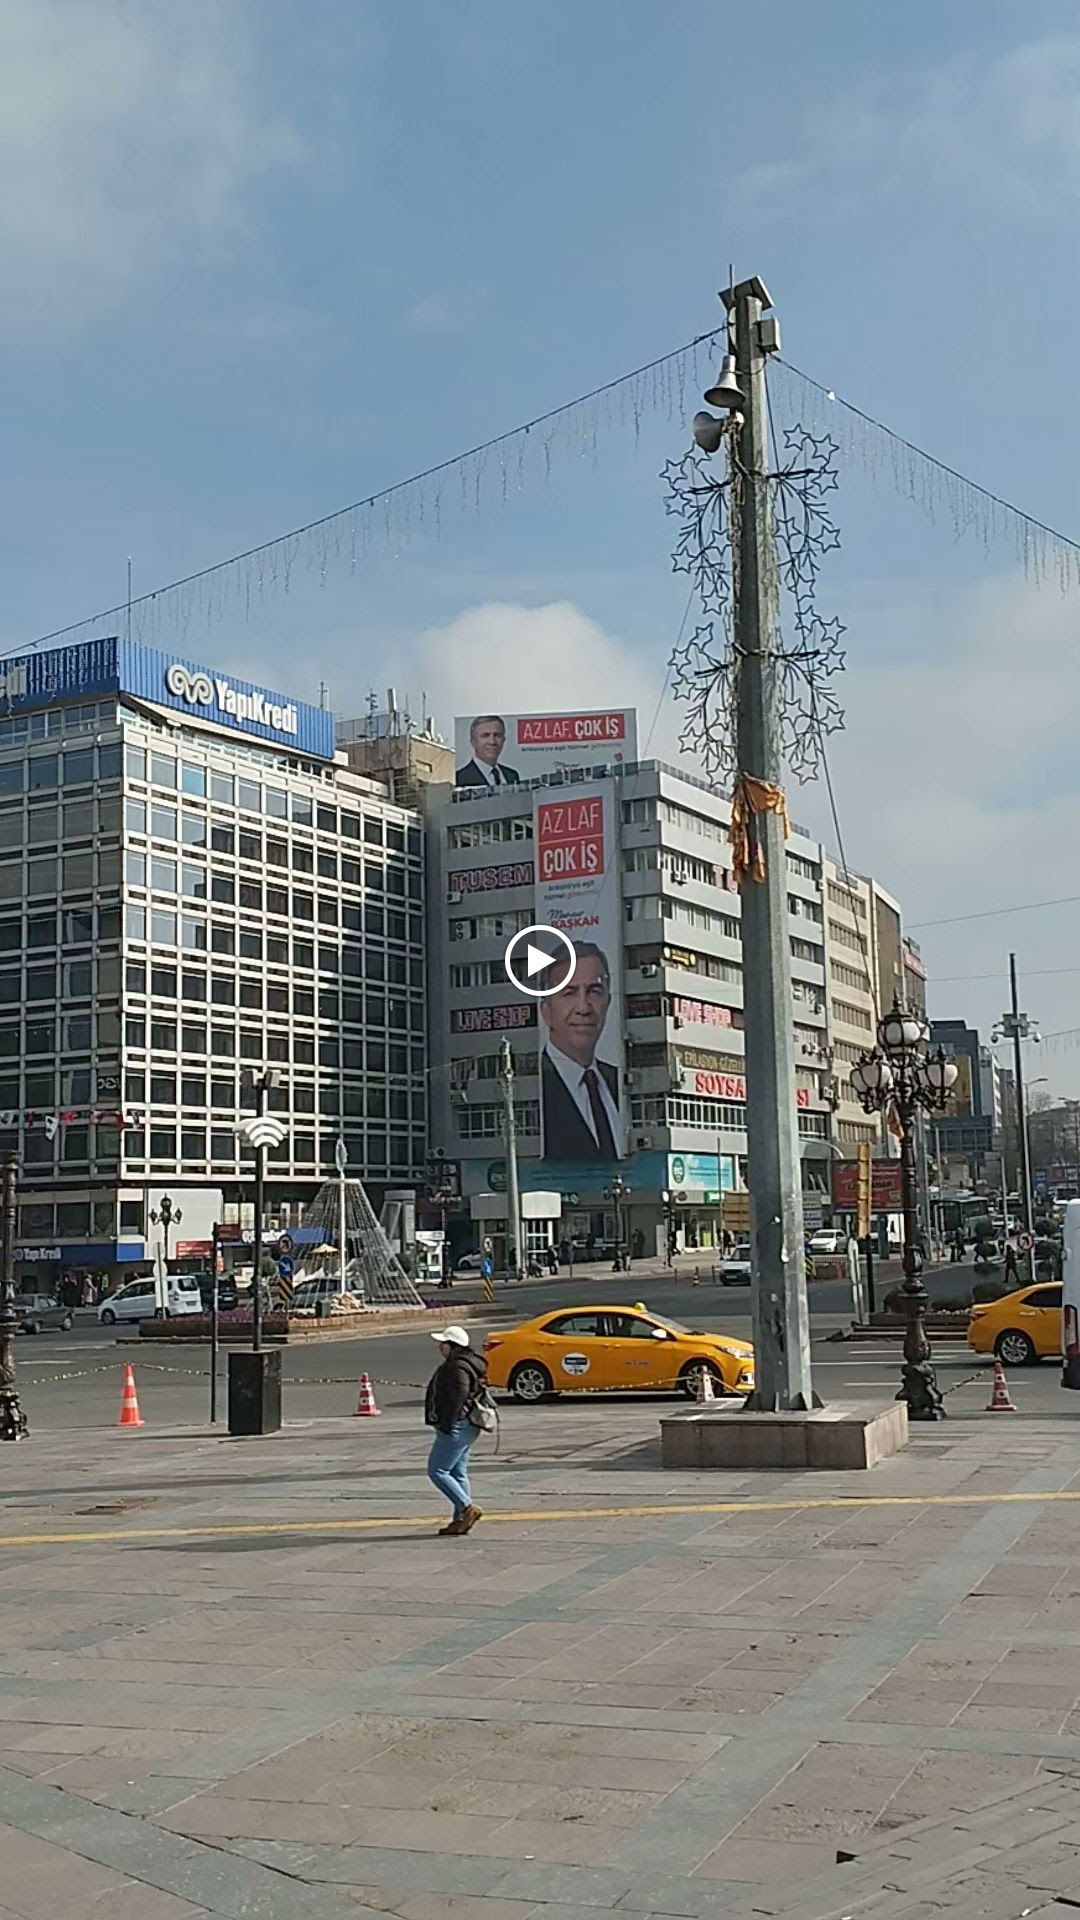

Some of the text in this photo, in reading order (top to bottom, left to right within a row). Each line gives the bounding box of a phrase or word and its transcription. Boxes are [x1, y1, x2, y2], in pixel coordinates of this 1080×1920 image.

[523, 722, 542, 740] AZ
[575, 719, 603, 740] ÇOK
[605, 715, 619, 738] İŞ
[540, 802, 600, 836] AZ LAF
[543, 840, 598, 879] ÇOK İŞ
[451, 863, 533, 894] TUSEM
[456, 1005, 530, 1032] LOVE SHOP
[673, 997, 732, 1028] LOVE SHOP
[695, 1072, 746, 1098] SOYSA
